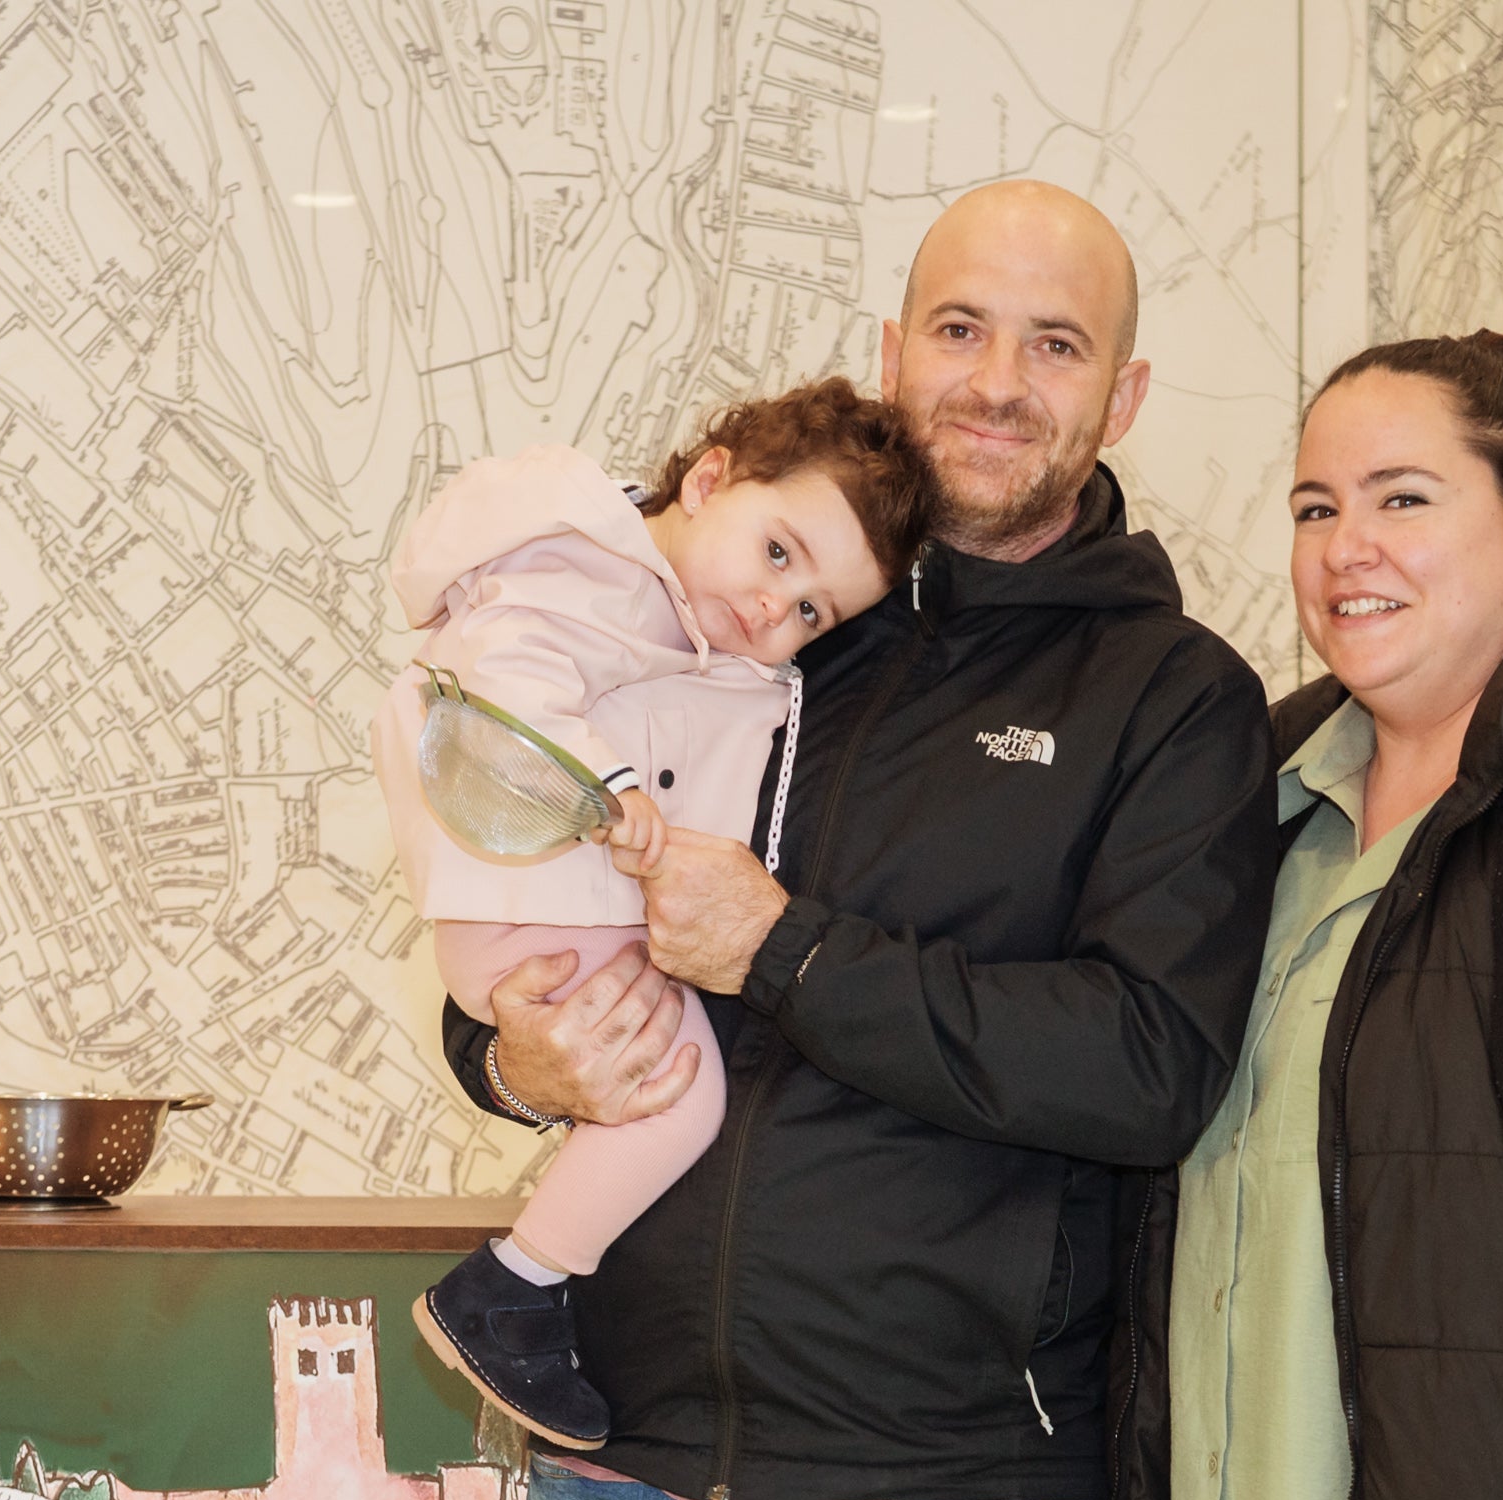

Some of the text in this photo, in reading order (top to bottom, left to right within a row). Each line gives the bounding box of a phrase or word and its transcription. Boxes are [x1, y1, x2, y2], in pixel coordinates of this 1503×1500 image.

[975, 731, 1032, 753] NORTH
[1006, 725, 1036, 742] THE
[985, 744, 1025, 762] FACE
